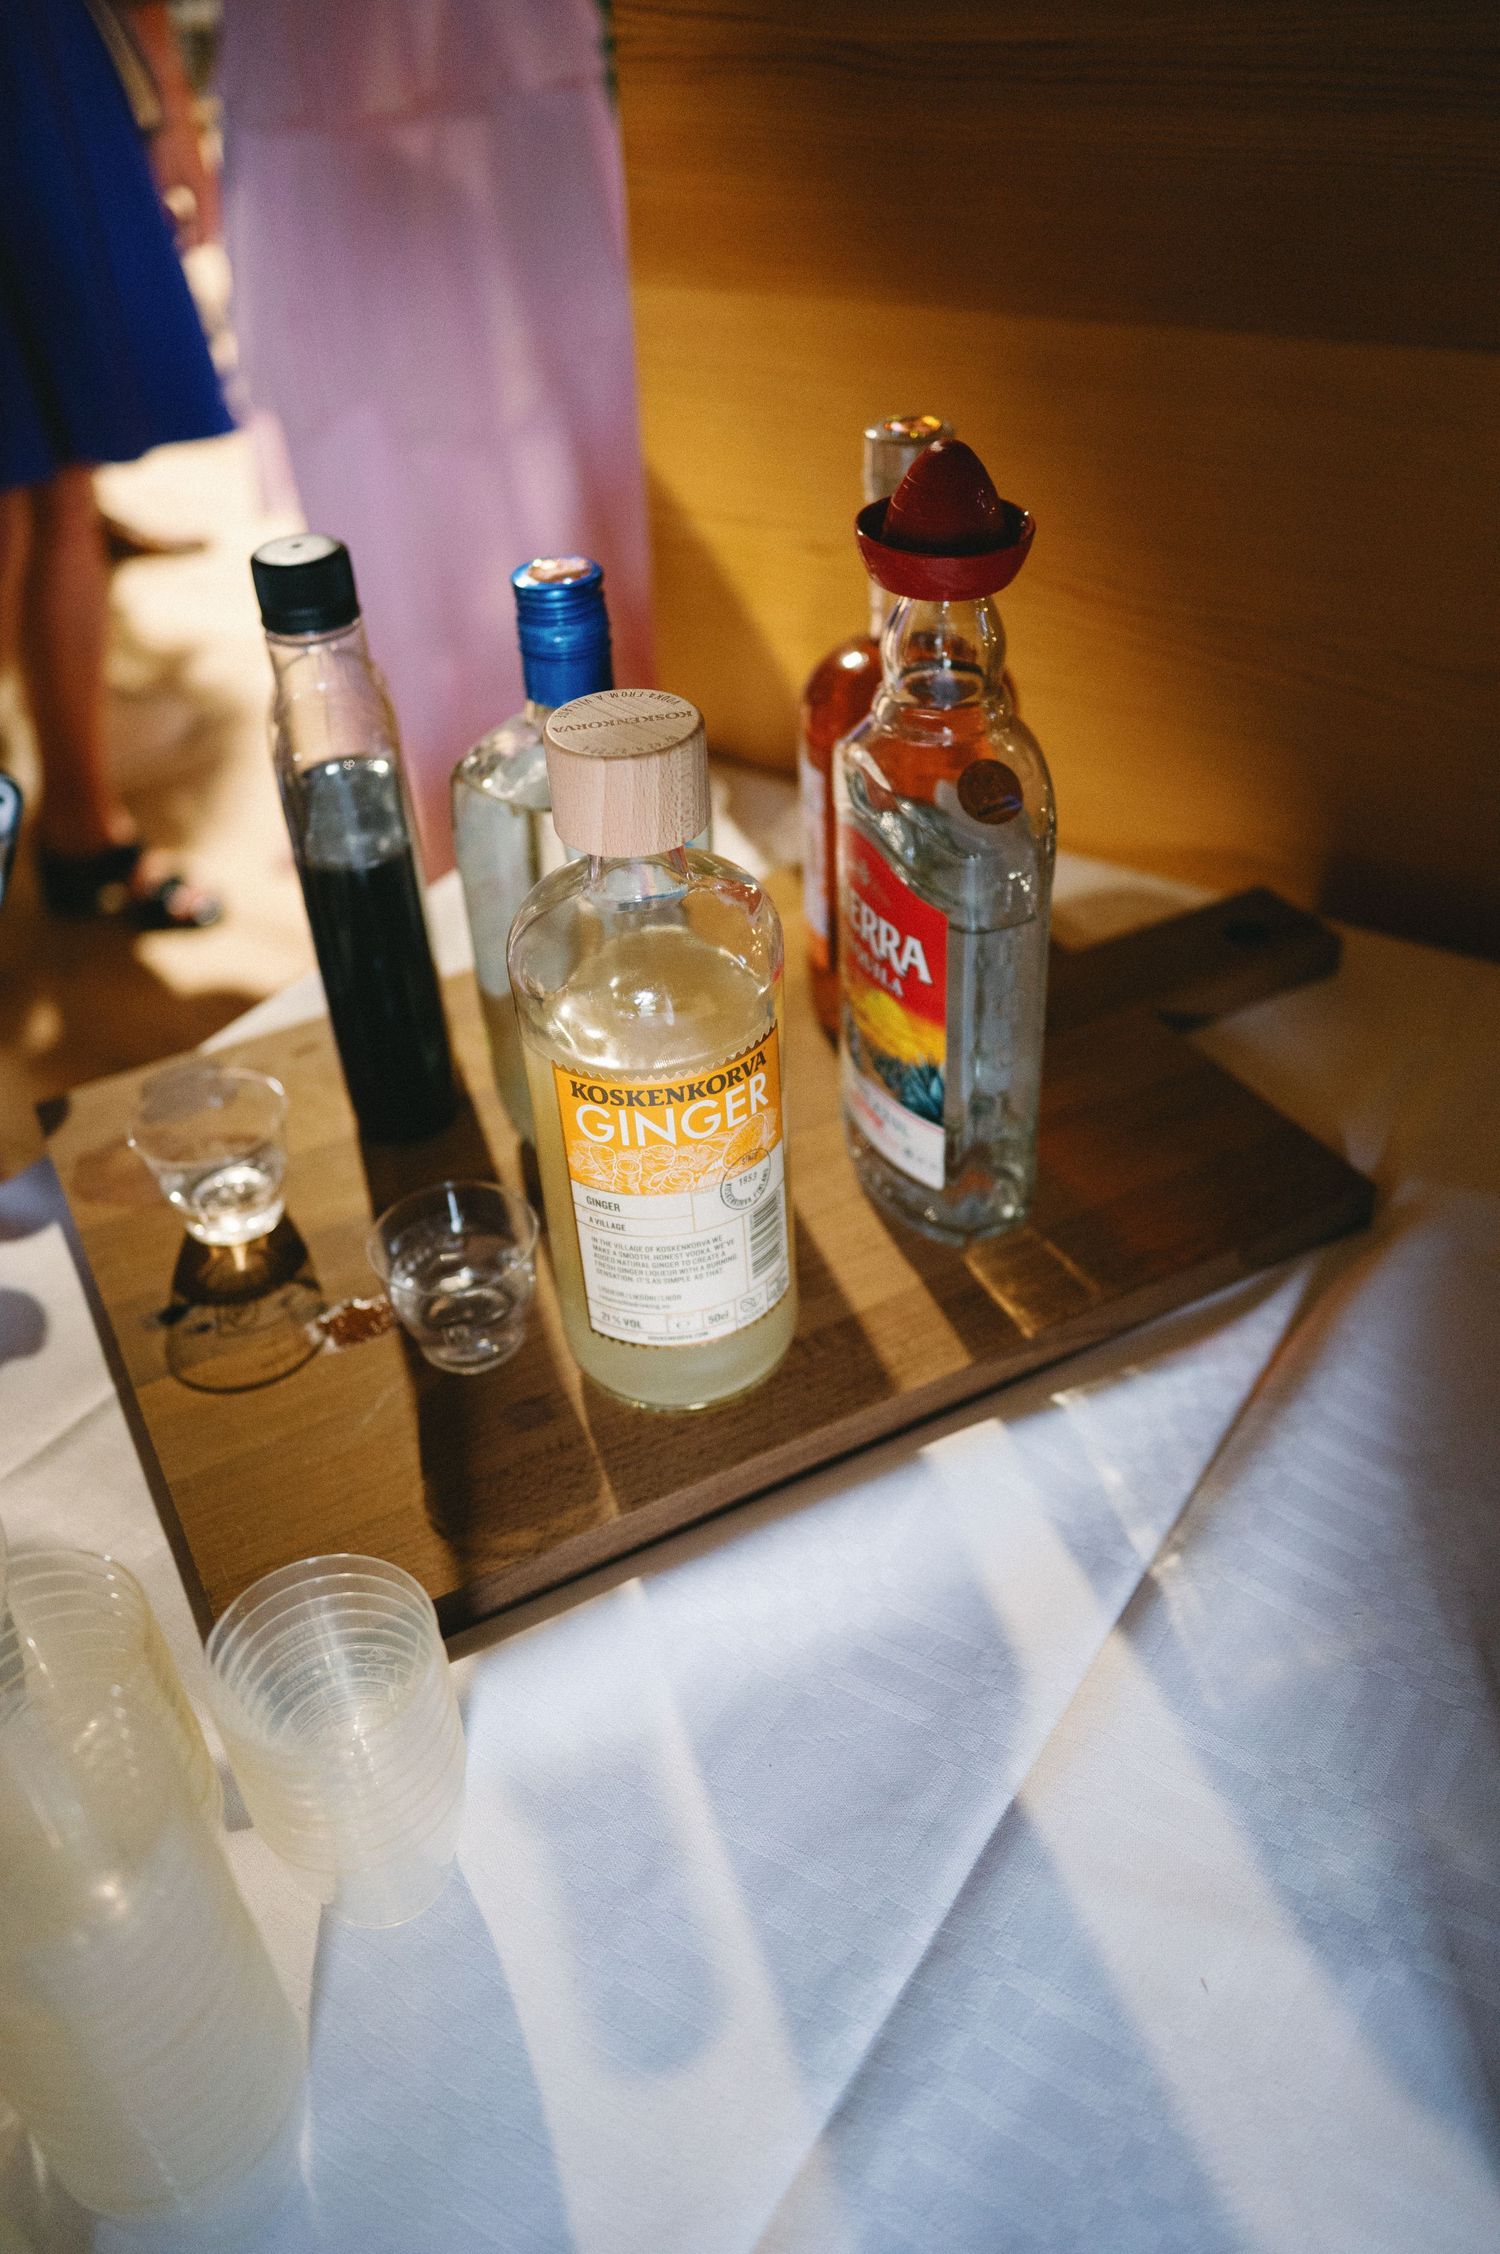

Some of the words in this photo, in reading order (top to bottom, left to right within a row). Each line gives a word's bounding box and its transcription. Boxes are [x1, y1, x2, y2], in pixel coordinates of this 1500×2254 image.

[551, 710, 693, 733] KOSKENKORVA
[570, 1050, 767, 1107] KOSKENKORVA
[575, 1072, 769, 1146] GINGER
[586, 1195, 621, 1212] GINGER
[595, 1217, 626, 1231] VILLAGE
[600, 1239, 611, 1247] THE
[614, 1242, 642, 1252] VILLAGE
[656, 1239, 711, 1253] KOSKENKORVA
[617, 1260, 648, 1268] NATURAL
[692, 1253, 719, 1265] CREATE
[653, 1252, 683, 1260] HONEST
[617, 1267, 643, 1276] GINGER
